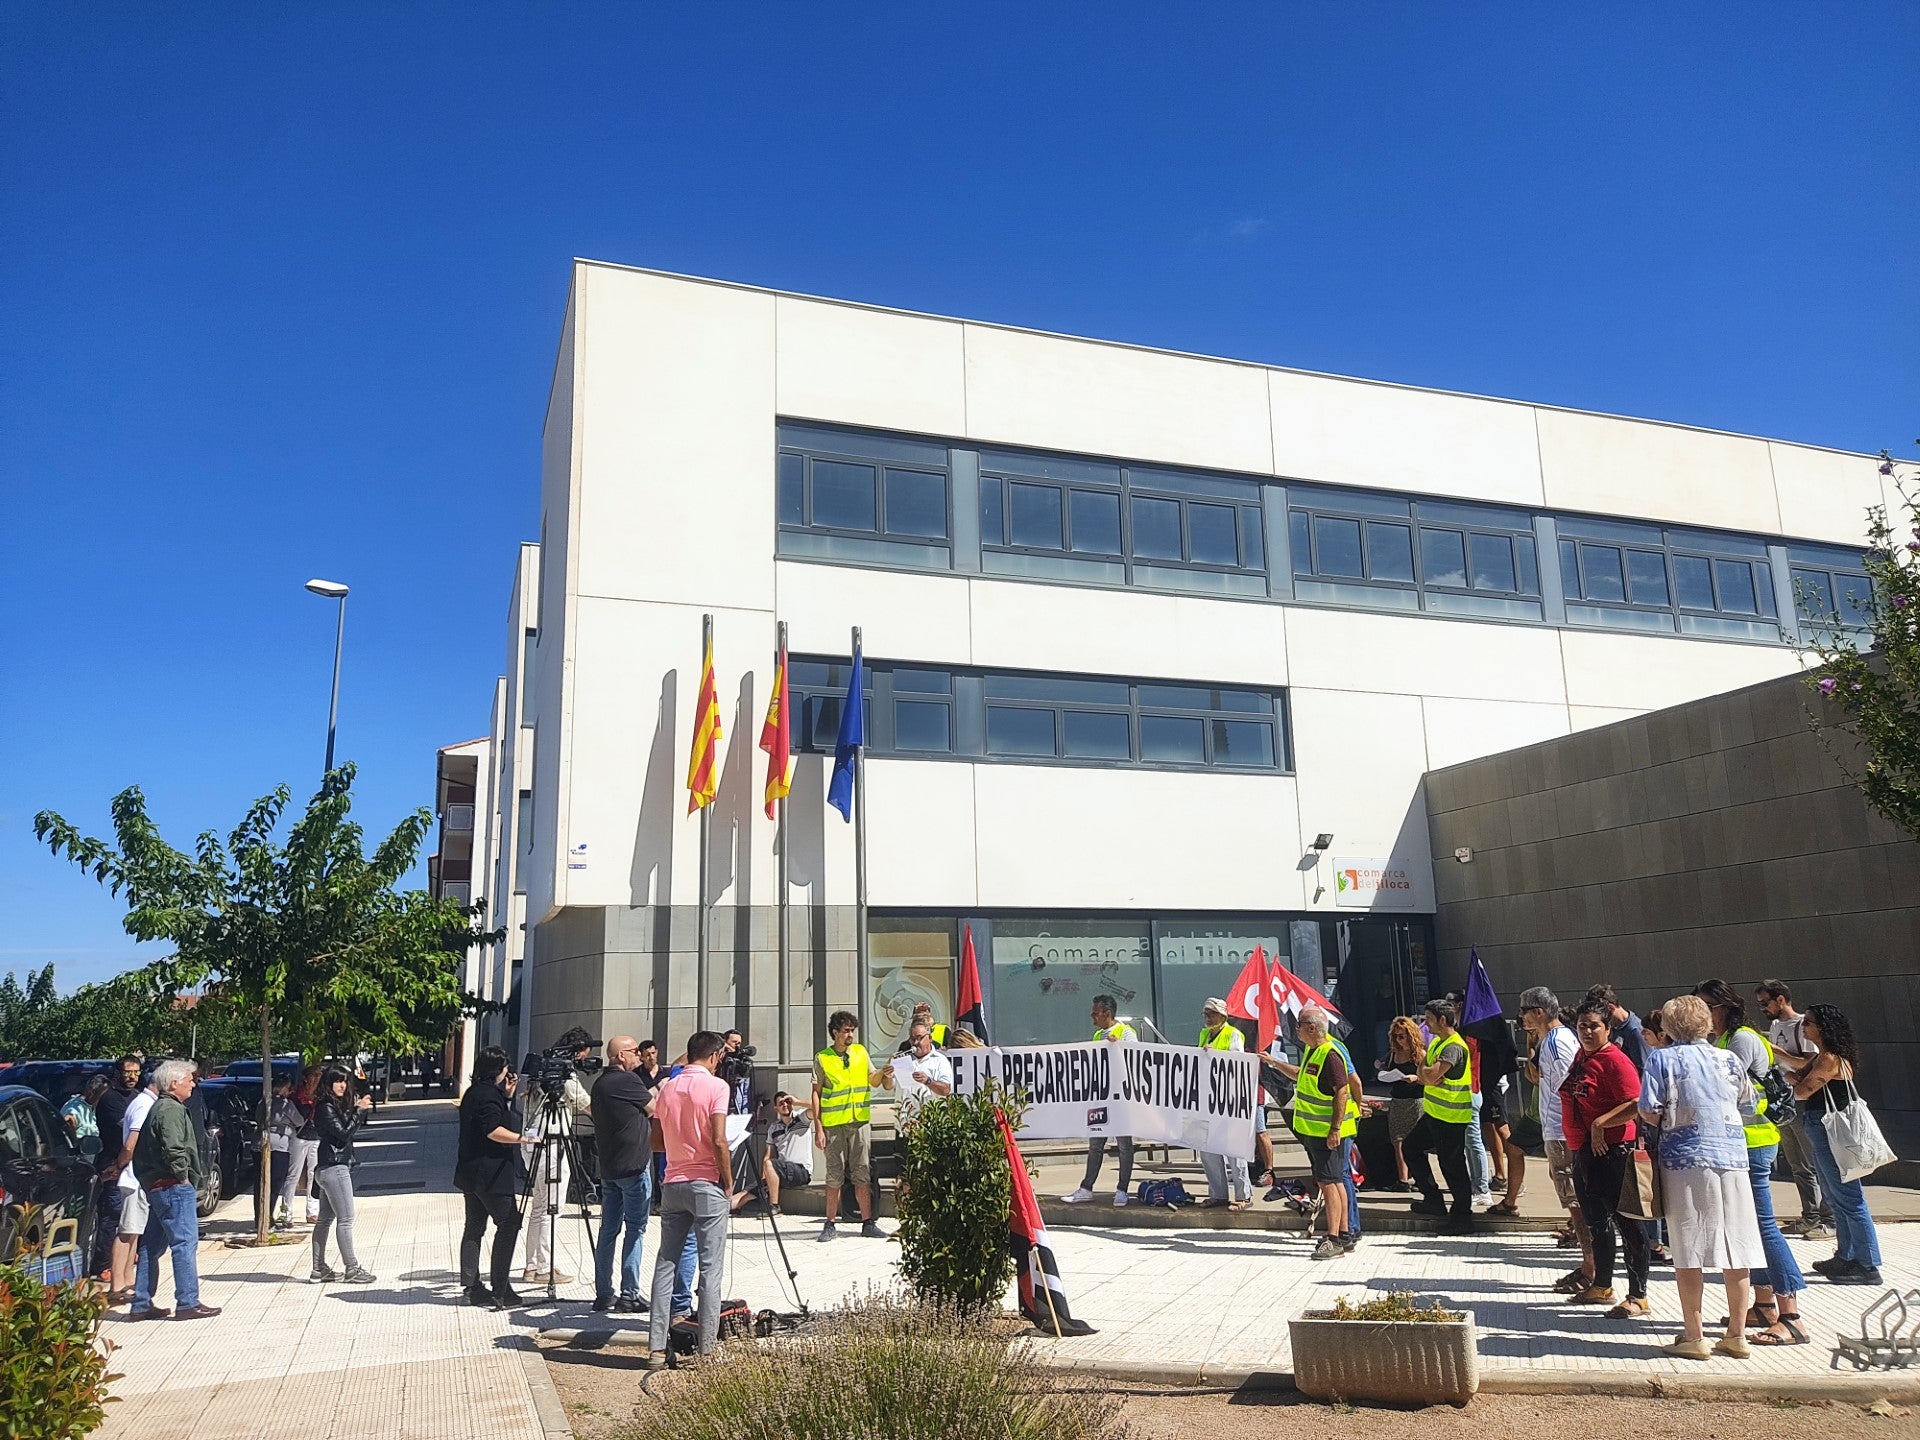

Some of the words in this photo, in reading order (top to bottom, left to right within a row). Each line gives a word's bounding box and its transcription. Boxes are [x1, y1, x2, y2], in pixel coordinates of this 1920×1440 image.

[1358, 869, 1405, 878] comarca
[1028, 942, 1145, 962] Comarca
[947, 1056, 963, 1095] E
[1122, 1048, 1200, 1112] JUSTICIA
[1089, 1111, 1104, 1121] CNT
